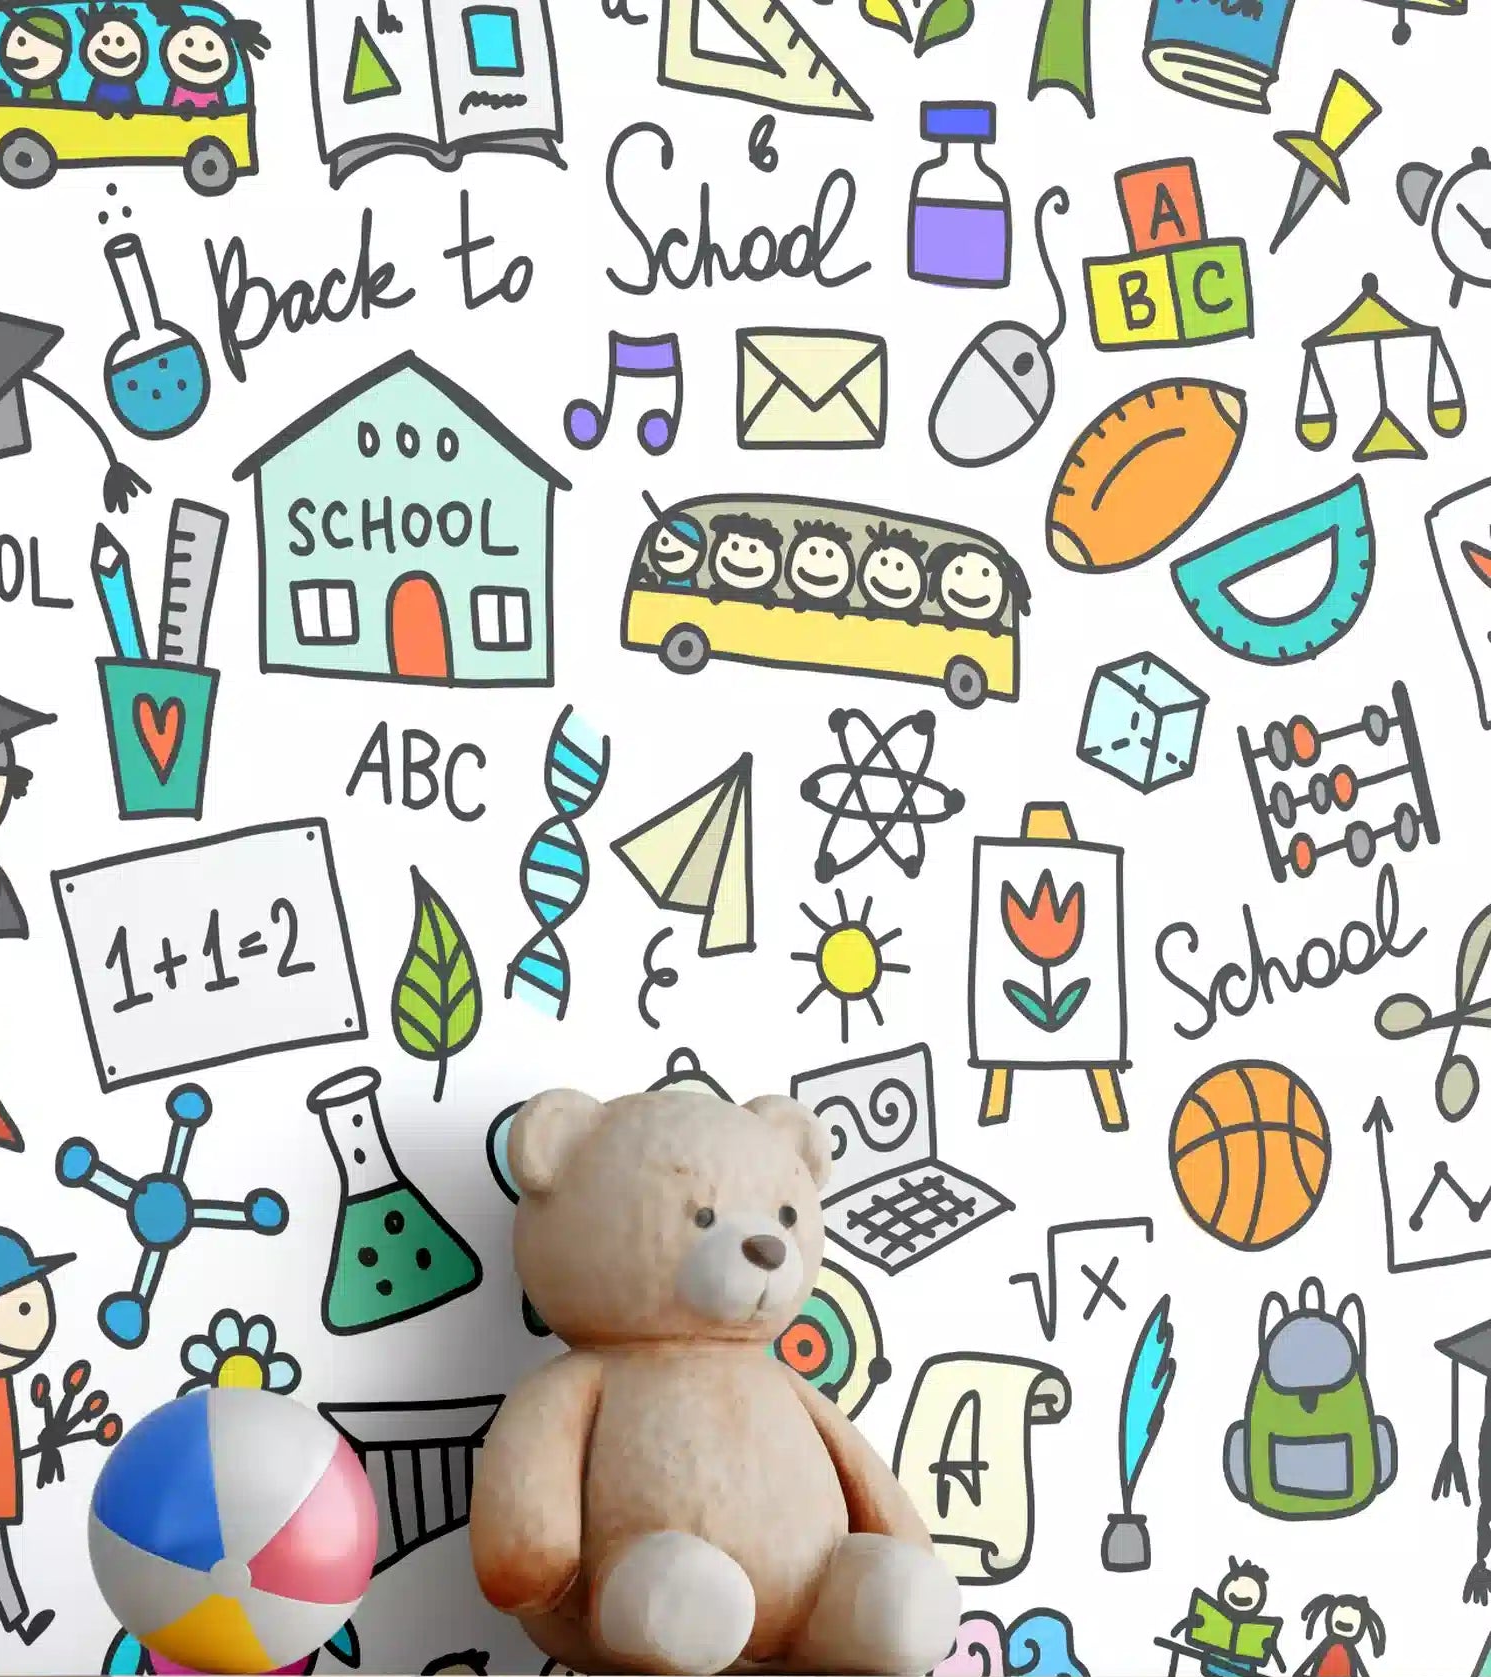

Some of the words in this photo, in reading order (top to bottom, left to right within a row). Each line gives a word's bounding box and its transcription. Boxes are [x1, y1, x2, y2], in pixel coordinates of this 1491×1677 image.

[204, 207, 416, 383] Back
[442, 189, 533, 310] to
[605, 121, 872, 296] School
[1150, 183, 1184, 240] A
[1118, 270, 1156, 331] B
[1192, 260, 1233, 314] C
[288, 495, 519, 557] SCHOOL
[345, 721, 487, 822] ABC
[1155, 862, 1428, 1041] School
[928, 1389, 989, 1519] A
